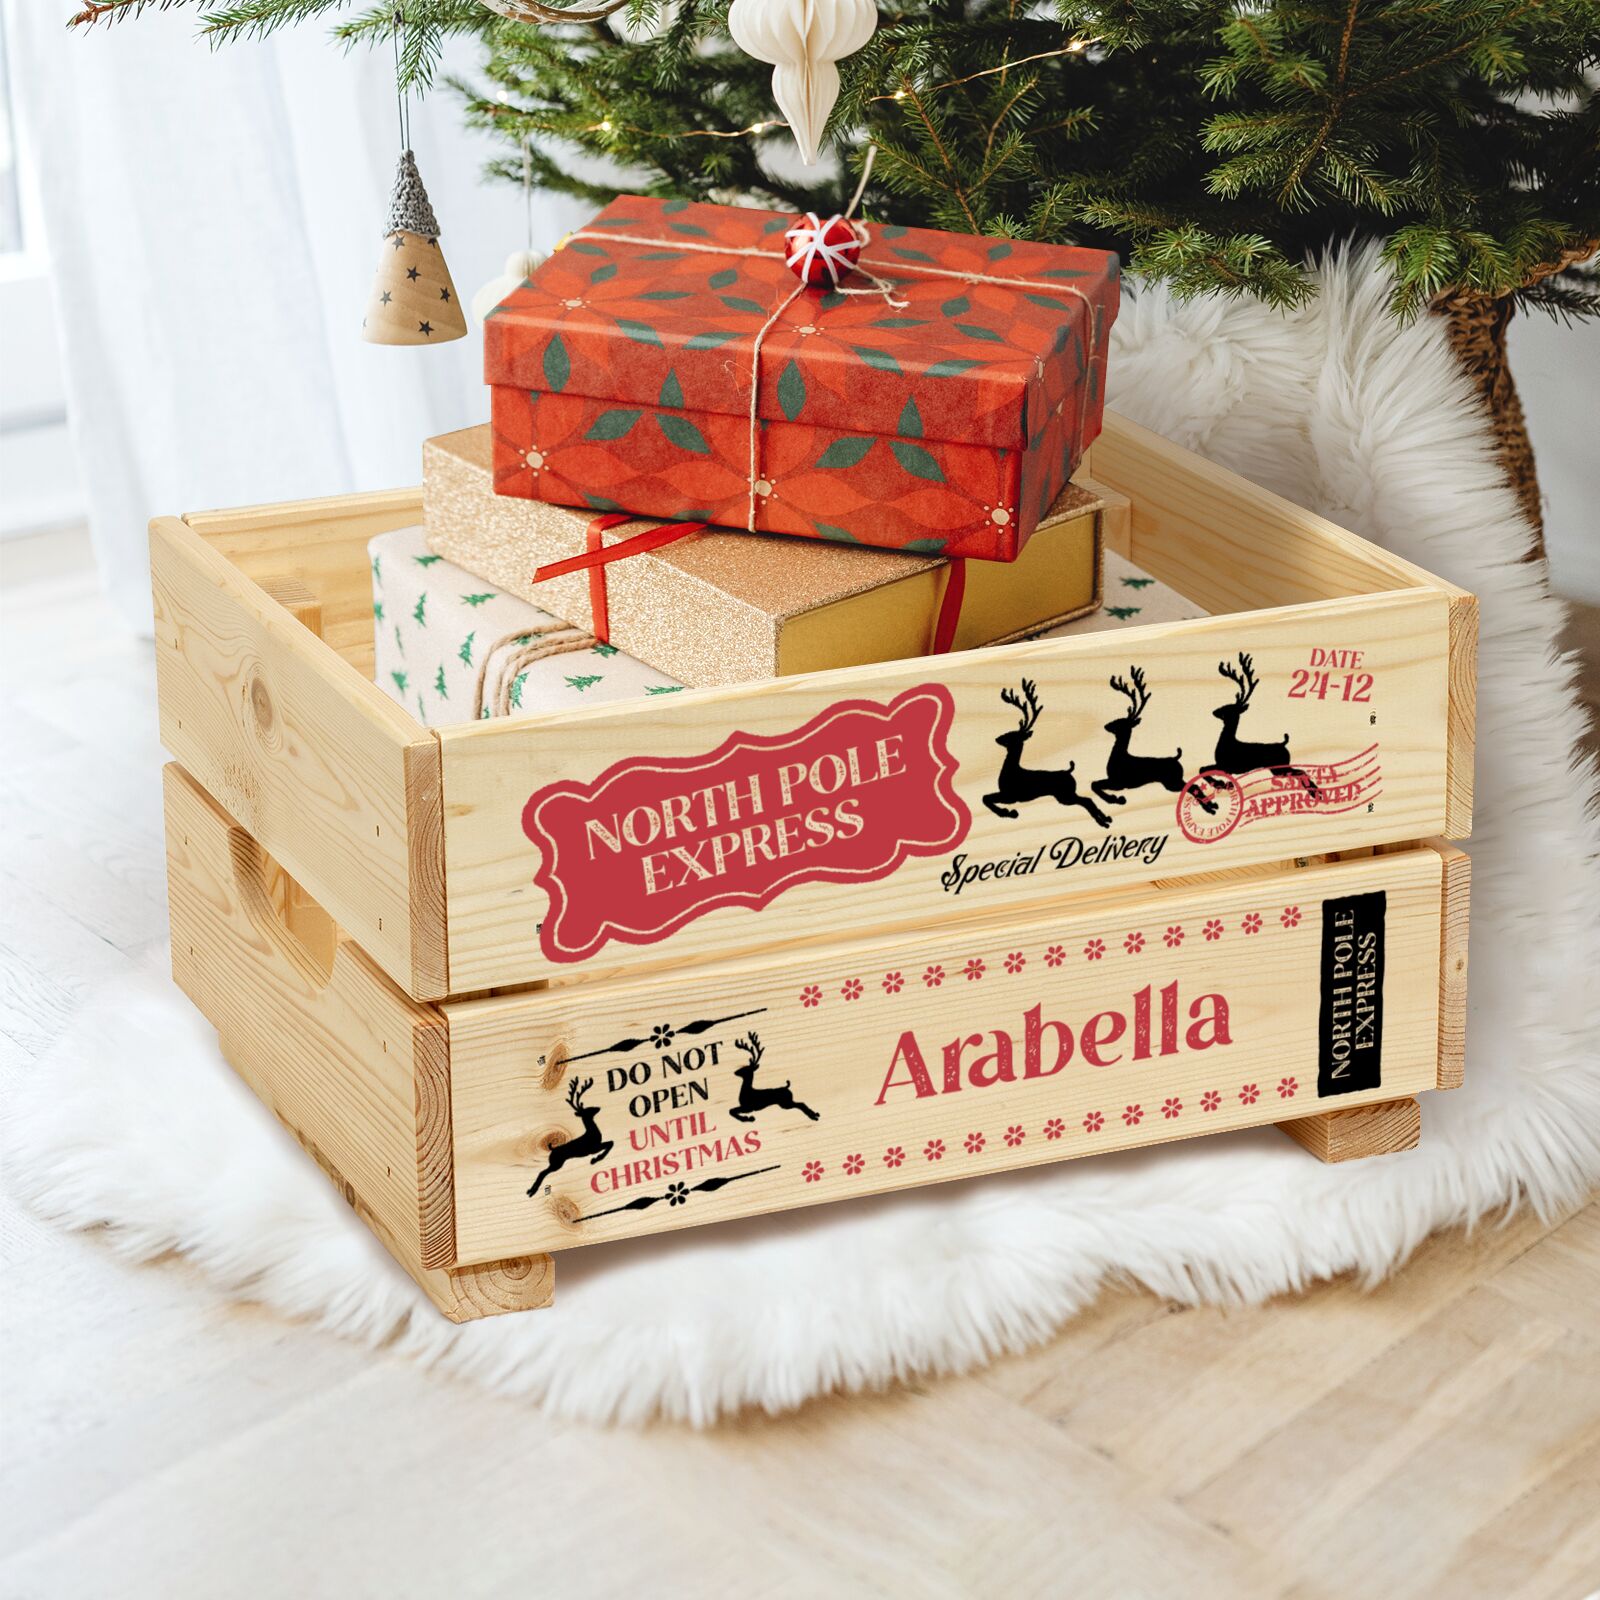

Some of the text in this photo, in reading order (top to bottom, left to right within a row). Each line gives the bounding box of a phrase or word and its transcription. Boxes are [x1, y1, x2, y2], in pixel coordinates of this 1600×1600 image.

[1288, 669, 1374, 703] 24-12
[1310, 648, 1365, 670] DATE
[584, 734, 908, 861] NORTH POLE
[1245, 783, 1361, 817] APPROVED
[640, 798, 865, 896] EXPRESS
[940, 834, 1169, 894] Special Delivery
[1331, 909, 1354, 1079] NORTH POLE
[1355, 931, 1377, 1050] EXPRESS
[607, 1041, 723, 1093] DO NOT
[874, 979, 1233, 1106] Arabella
[629, 1077, 709, 1118] OPEN
[629, 1111, 717, 1152] UNTIL
[590, 1130, 762, 1195] CHRISTMAS
